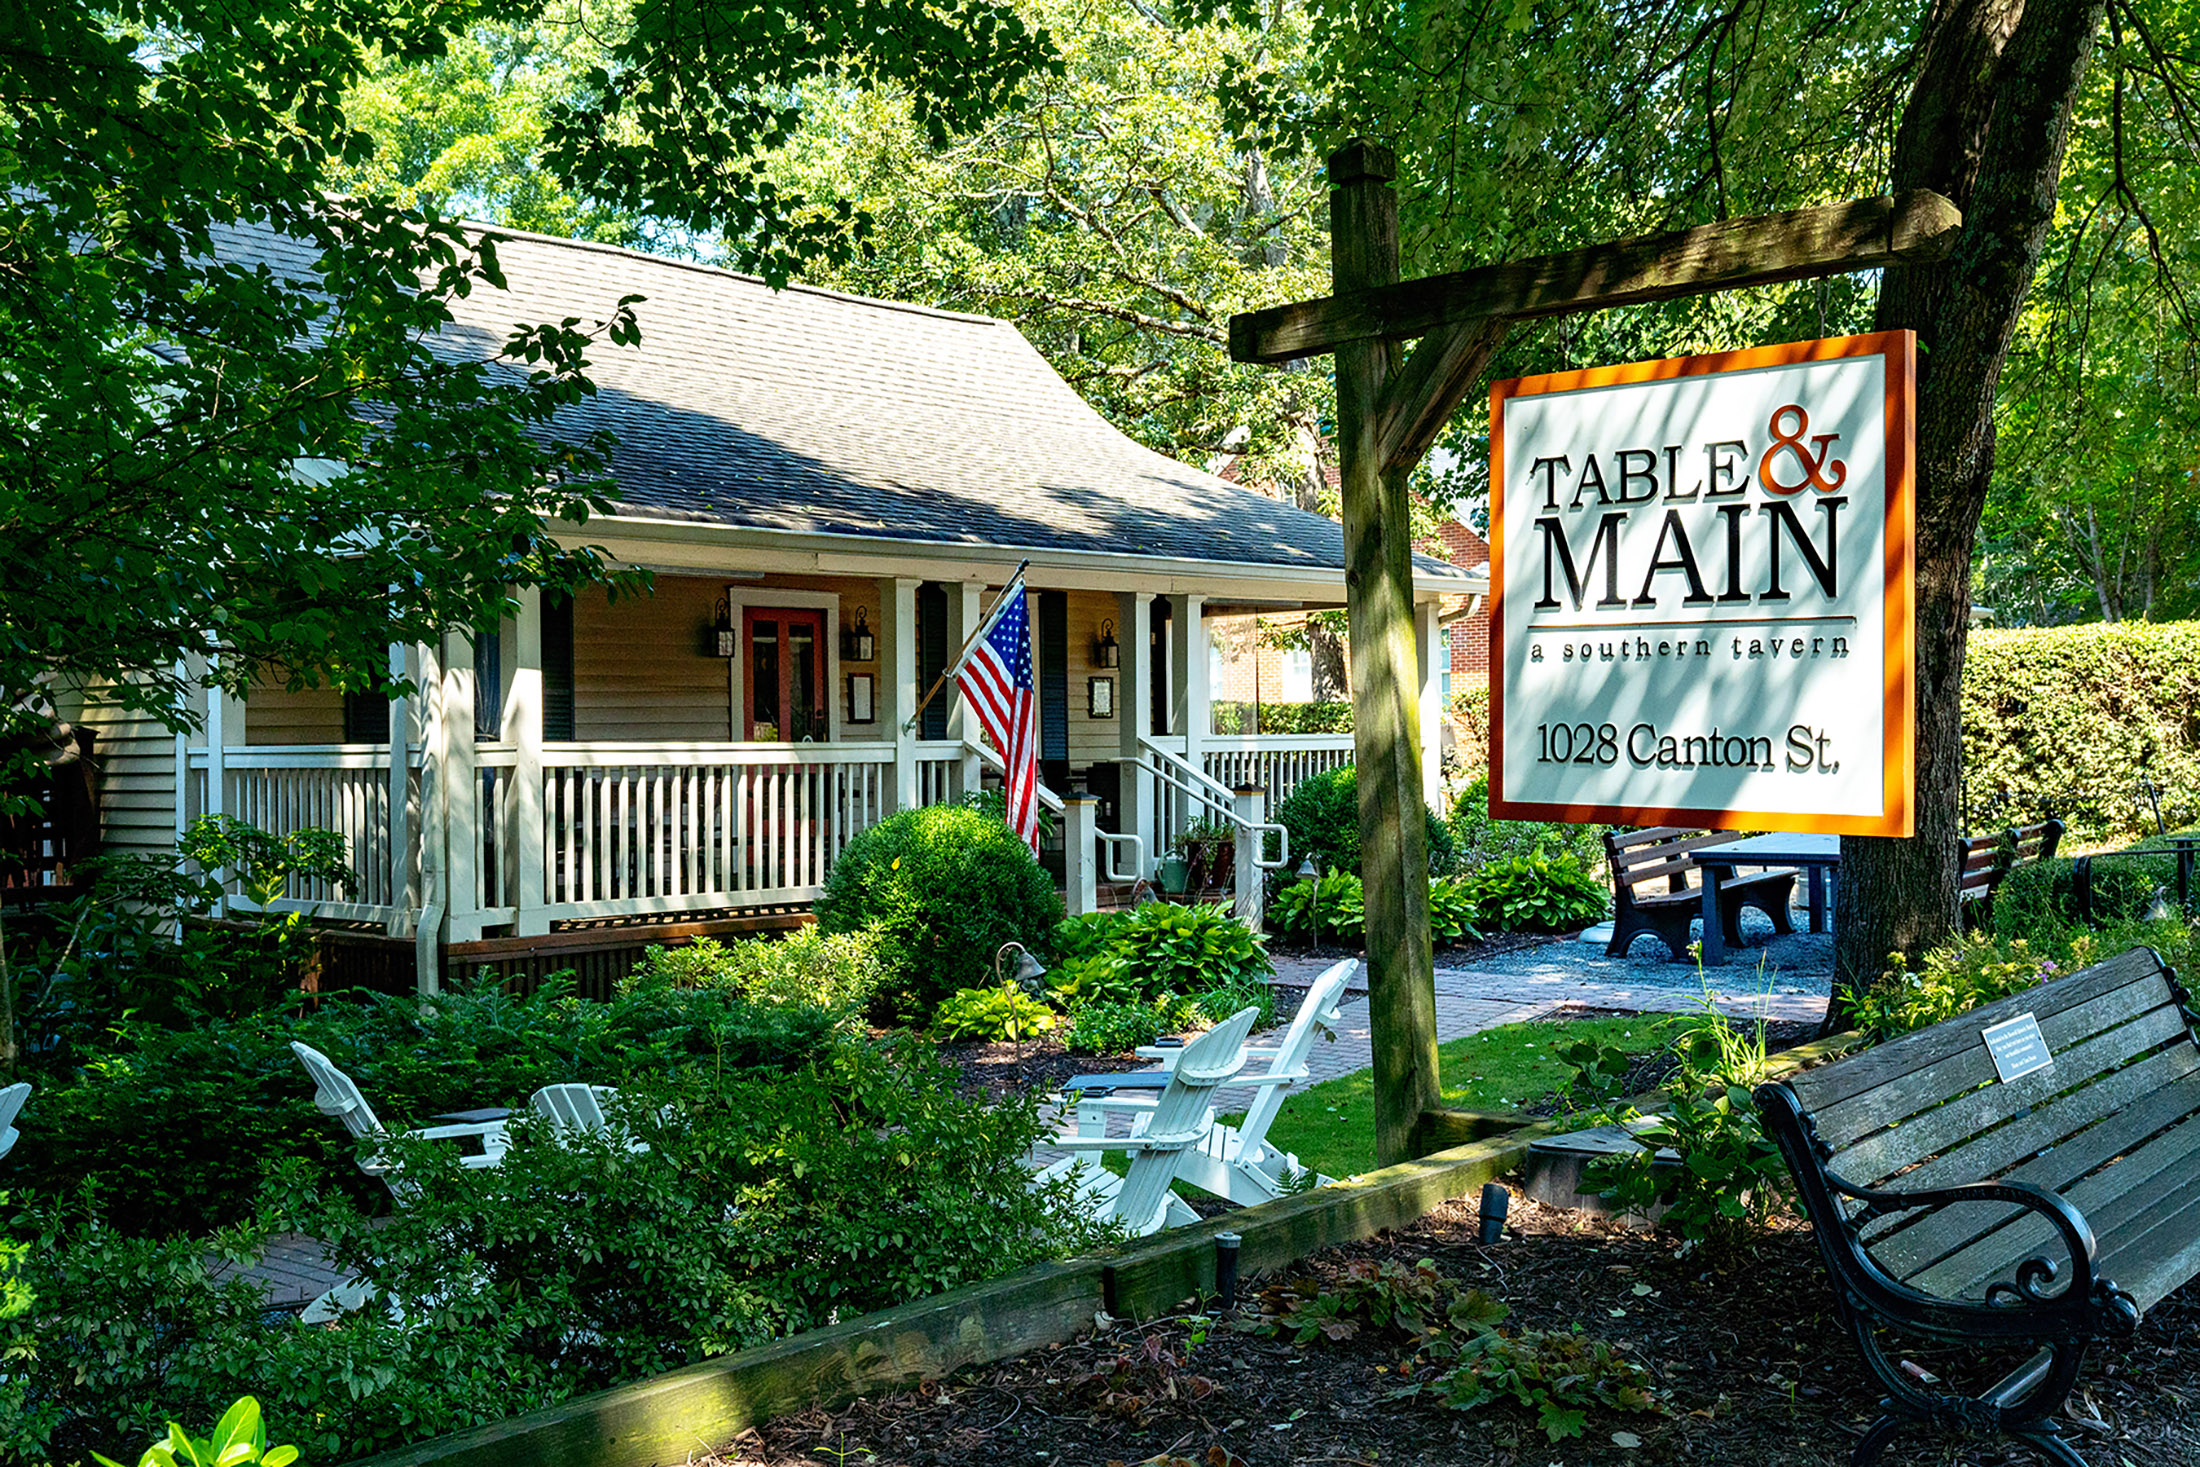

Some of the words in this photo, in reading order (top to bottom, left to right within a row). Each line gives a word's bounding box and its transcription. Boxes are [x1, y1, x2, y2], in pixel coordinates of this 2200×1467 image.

[1529, 439, 1751, 511] TABLE
[1533, 496, 1849, 611] MAIN
[1531, 643, 1543, 660] a
[1562, 636, 1711, 660] southern
[1732, 635, 1850, 657] tavern
[1536, 722, 1619, 766] 1028
[1626, 722, 1775, 768] Canton
